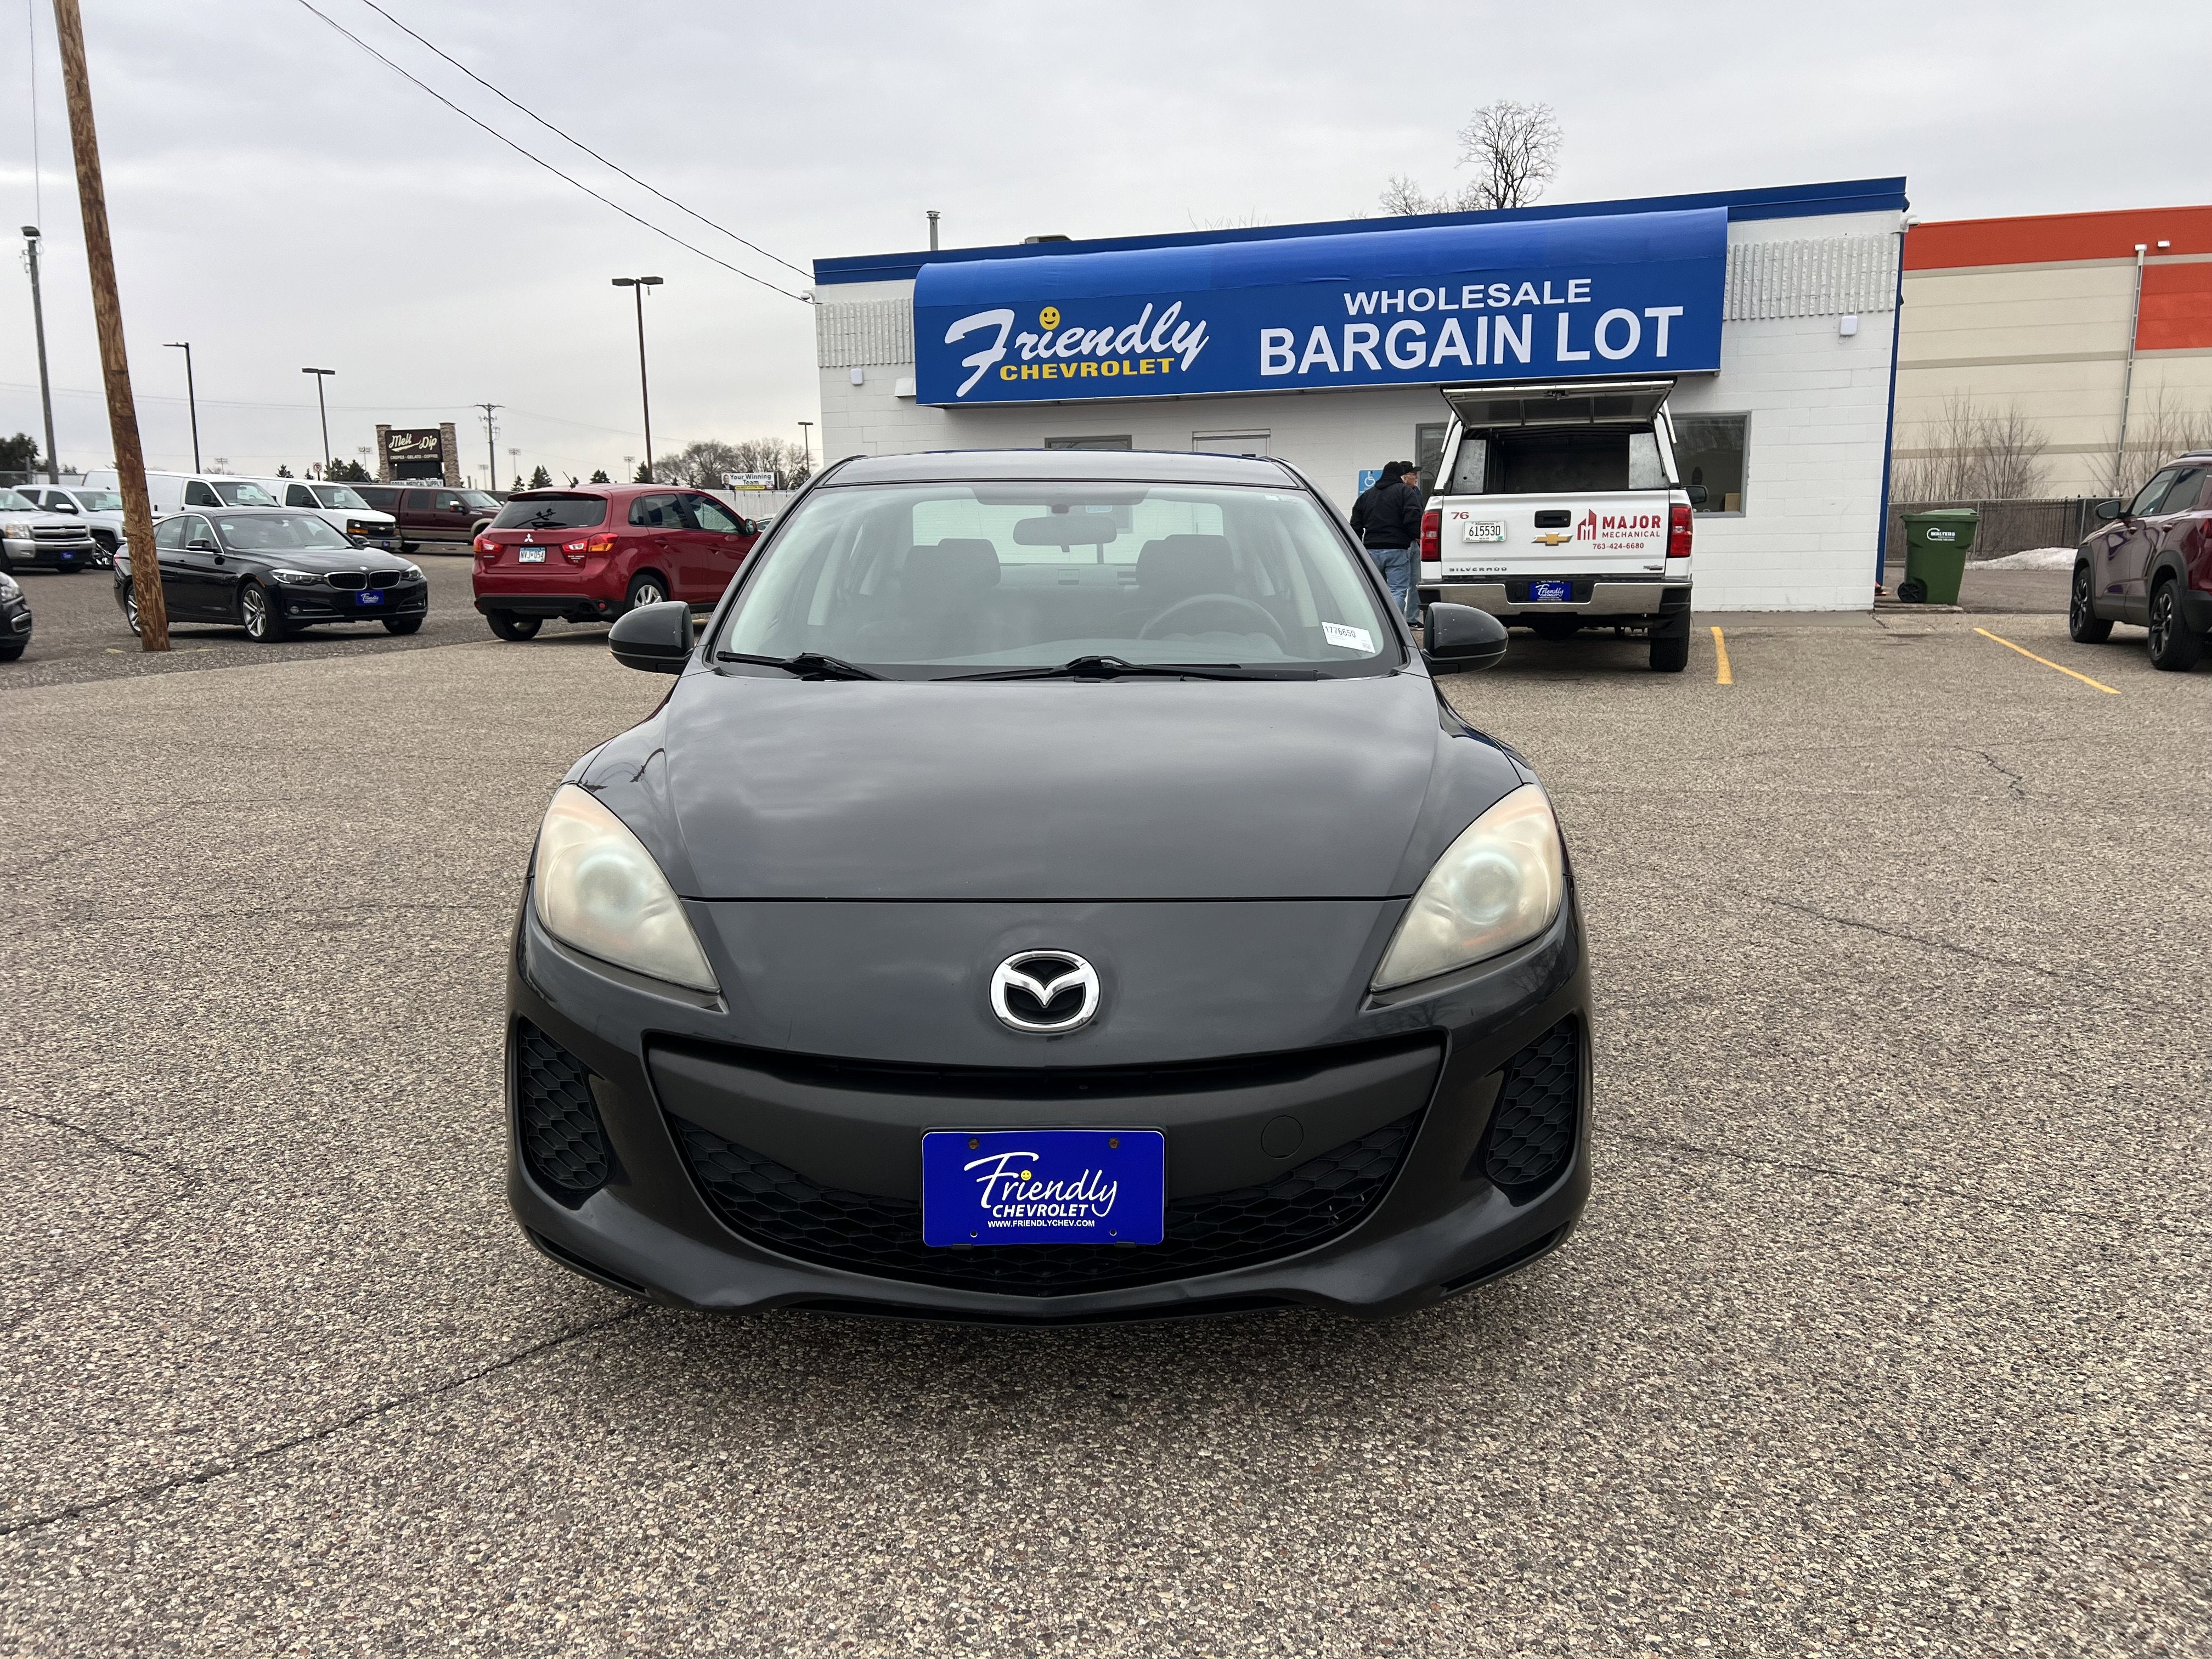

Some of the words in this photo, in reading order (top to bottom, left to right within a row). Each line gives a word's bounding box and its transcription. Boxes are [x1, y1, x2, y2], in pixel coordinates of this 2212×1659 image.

[1344, 278, 1592, 316] WHOLESALE
[1260, 313, 1533, 376] BARGAIN
[1556, 306, 1684, 362] LOT
[944, 300, 1209, 398] Friendly
[1000, 357, 1175, 381] CHEVROLET
[388, 433, 412, 448] Melt
[419, 435, 437, 450] Dip
[1451, 511, 1469, 520] 76
[1602, 515, 1661, 529] MAJOR
[1535, 584, 1564, 597] Friendly
[1325, 626, 1356, 638] 1776650
[964, 1152, 1117, 1217] Friendly
[992, 1203, 1088, 1217] CHEVROLET
[988, 1219, 1095, 1228] WWW.FRIENDLYCHEV.COM
